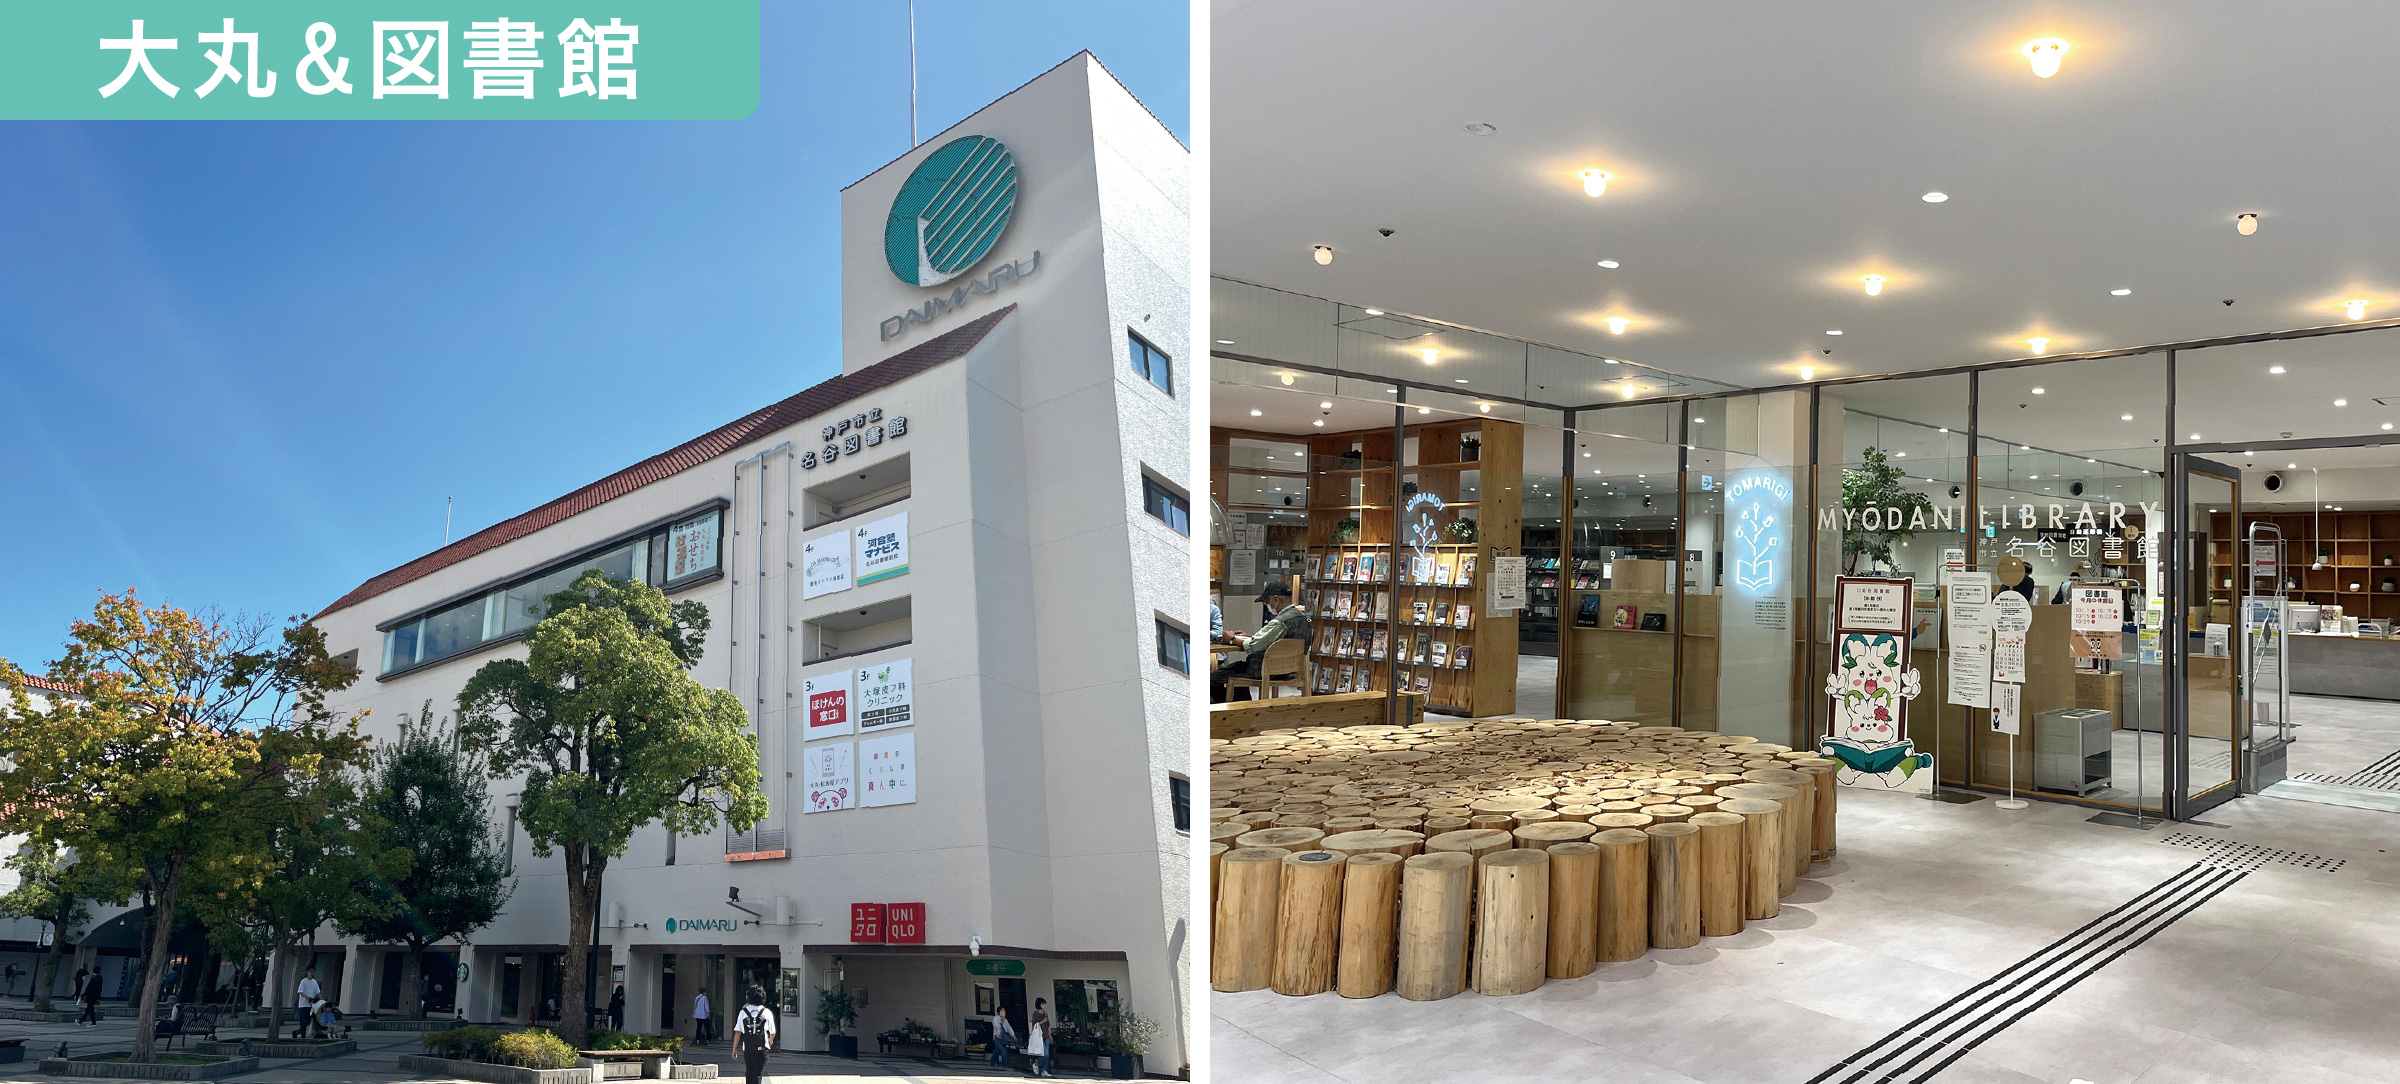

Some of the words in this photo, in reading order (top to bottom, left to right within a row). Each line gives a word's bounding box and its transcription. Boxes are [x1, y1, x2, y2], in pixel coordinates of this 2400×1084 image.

[880, 250, 1041, 342] DAIMARU
[821, 407, 884, 442] 神戸市立
[800, 415, 908, 471] 名谷図書館
[1725, 476, 1790, 503] TOMARIGI
[1979, 501, 2159, 530] LIBRARY
[857, 527, 868, 538] 4F
[867, 532, 896, 549] 河合塾
[1979, 537, 1999, 547] 神戸
[2006, 535, 2160, 560] 名谷図書館
[688, 529, 701, 572] おせち
[864, 541, 900, 559] マナビス
[1275, 549, 1285, 557] 10
[1610, 550, 1617, 561] 9
[1979, 549, 1998, 558] 市立
[1689, 553, 1695, 562] 8
[2085, 589, 2108, 598] 図書館
[863, 681, 906, 698] 大塚皮フ科
[811, 696, 845, 710] ほけんの
[867, 693, 903, 708] クリニック
[819, 708, 836, 722] 窓口
[855, 908, 877, 921] ユニ
[892, 908, 914, 921] UNI
[679, 918, 738, 932] DAIMARU
[854, 923, 877, 937] クロ
[891, 924, 915, 939] QLO
